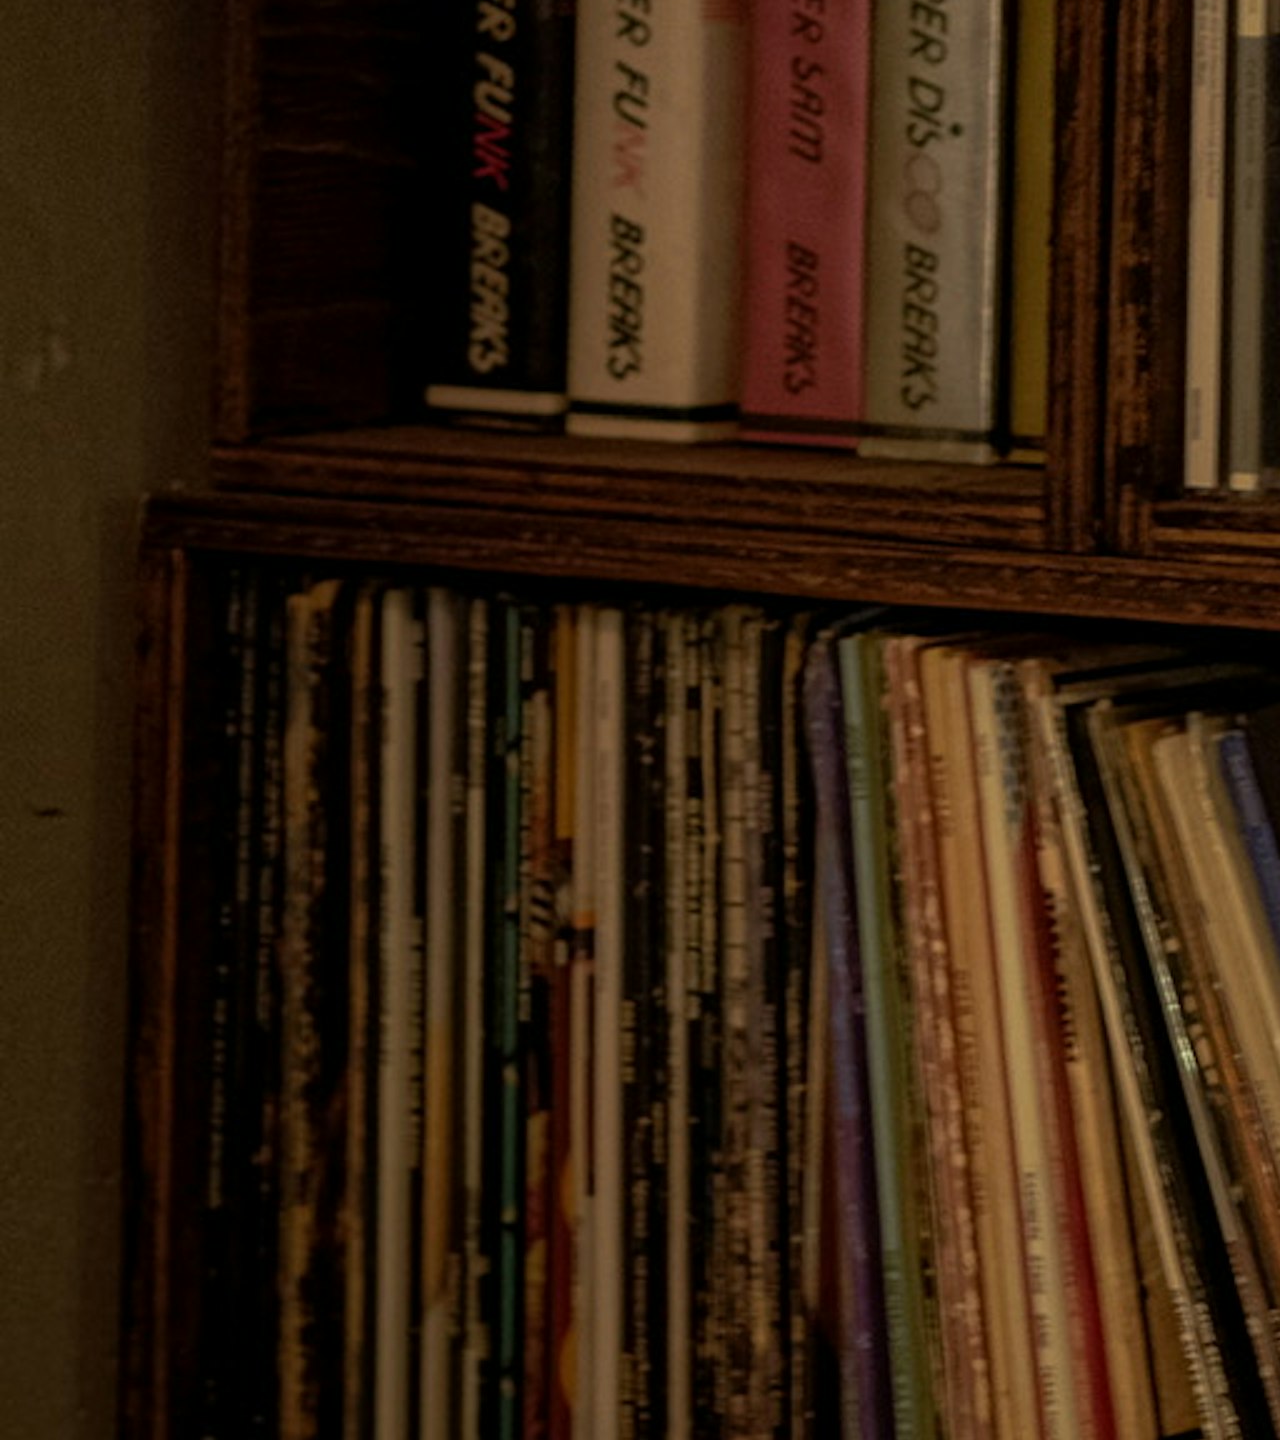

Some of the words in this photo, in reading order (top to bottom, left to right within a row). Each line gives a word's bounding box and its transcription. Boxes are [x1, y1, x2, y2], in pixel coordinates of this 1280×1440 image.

[470, 48, 516, 188] FUNK
[611, 61, 651, 191] FUNK
[469, 198, 514, 376] BREAKS
[605, 213, 645, 383] BREAKS
[782, 239, 821, 397] BREAKS
[902, 240, 943, 413] BREAKS
